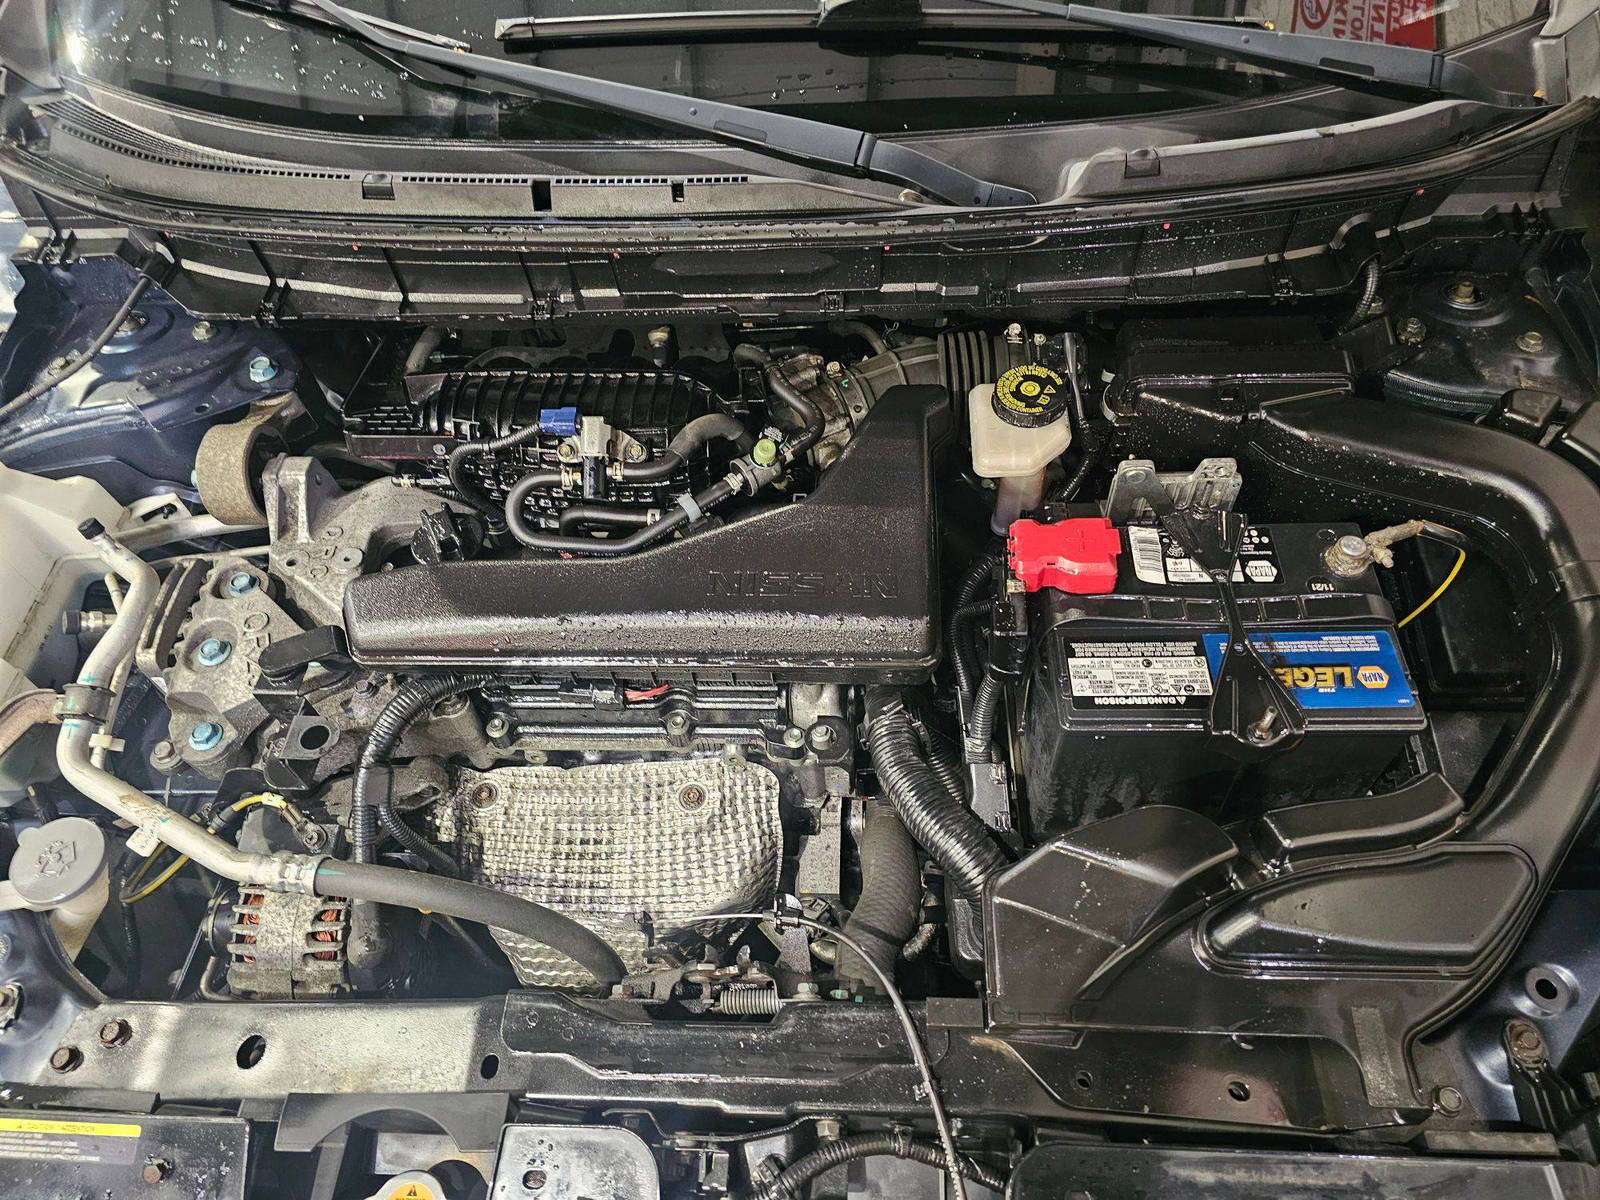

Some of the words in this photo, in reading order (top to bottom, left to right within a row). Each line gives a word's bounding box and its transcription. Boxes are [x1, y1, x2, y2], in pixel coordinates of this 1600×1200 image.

[1250, 565, 1273, 577] NAPA
[706, 570, 898, 599] NISSAN
[1311, 583, 1335, 591] 11/21
[1273, 665, 1354, 688] LEGE
[1362, 671, 1385, 683] NAPA
